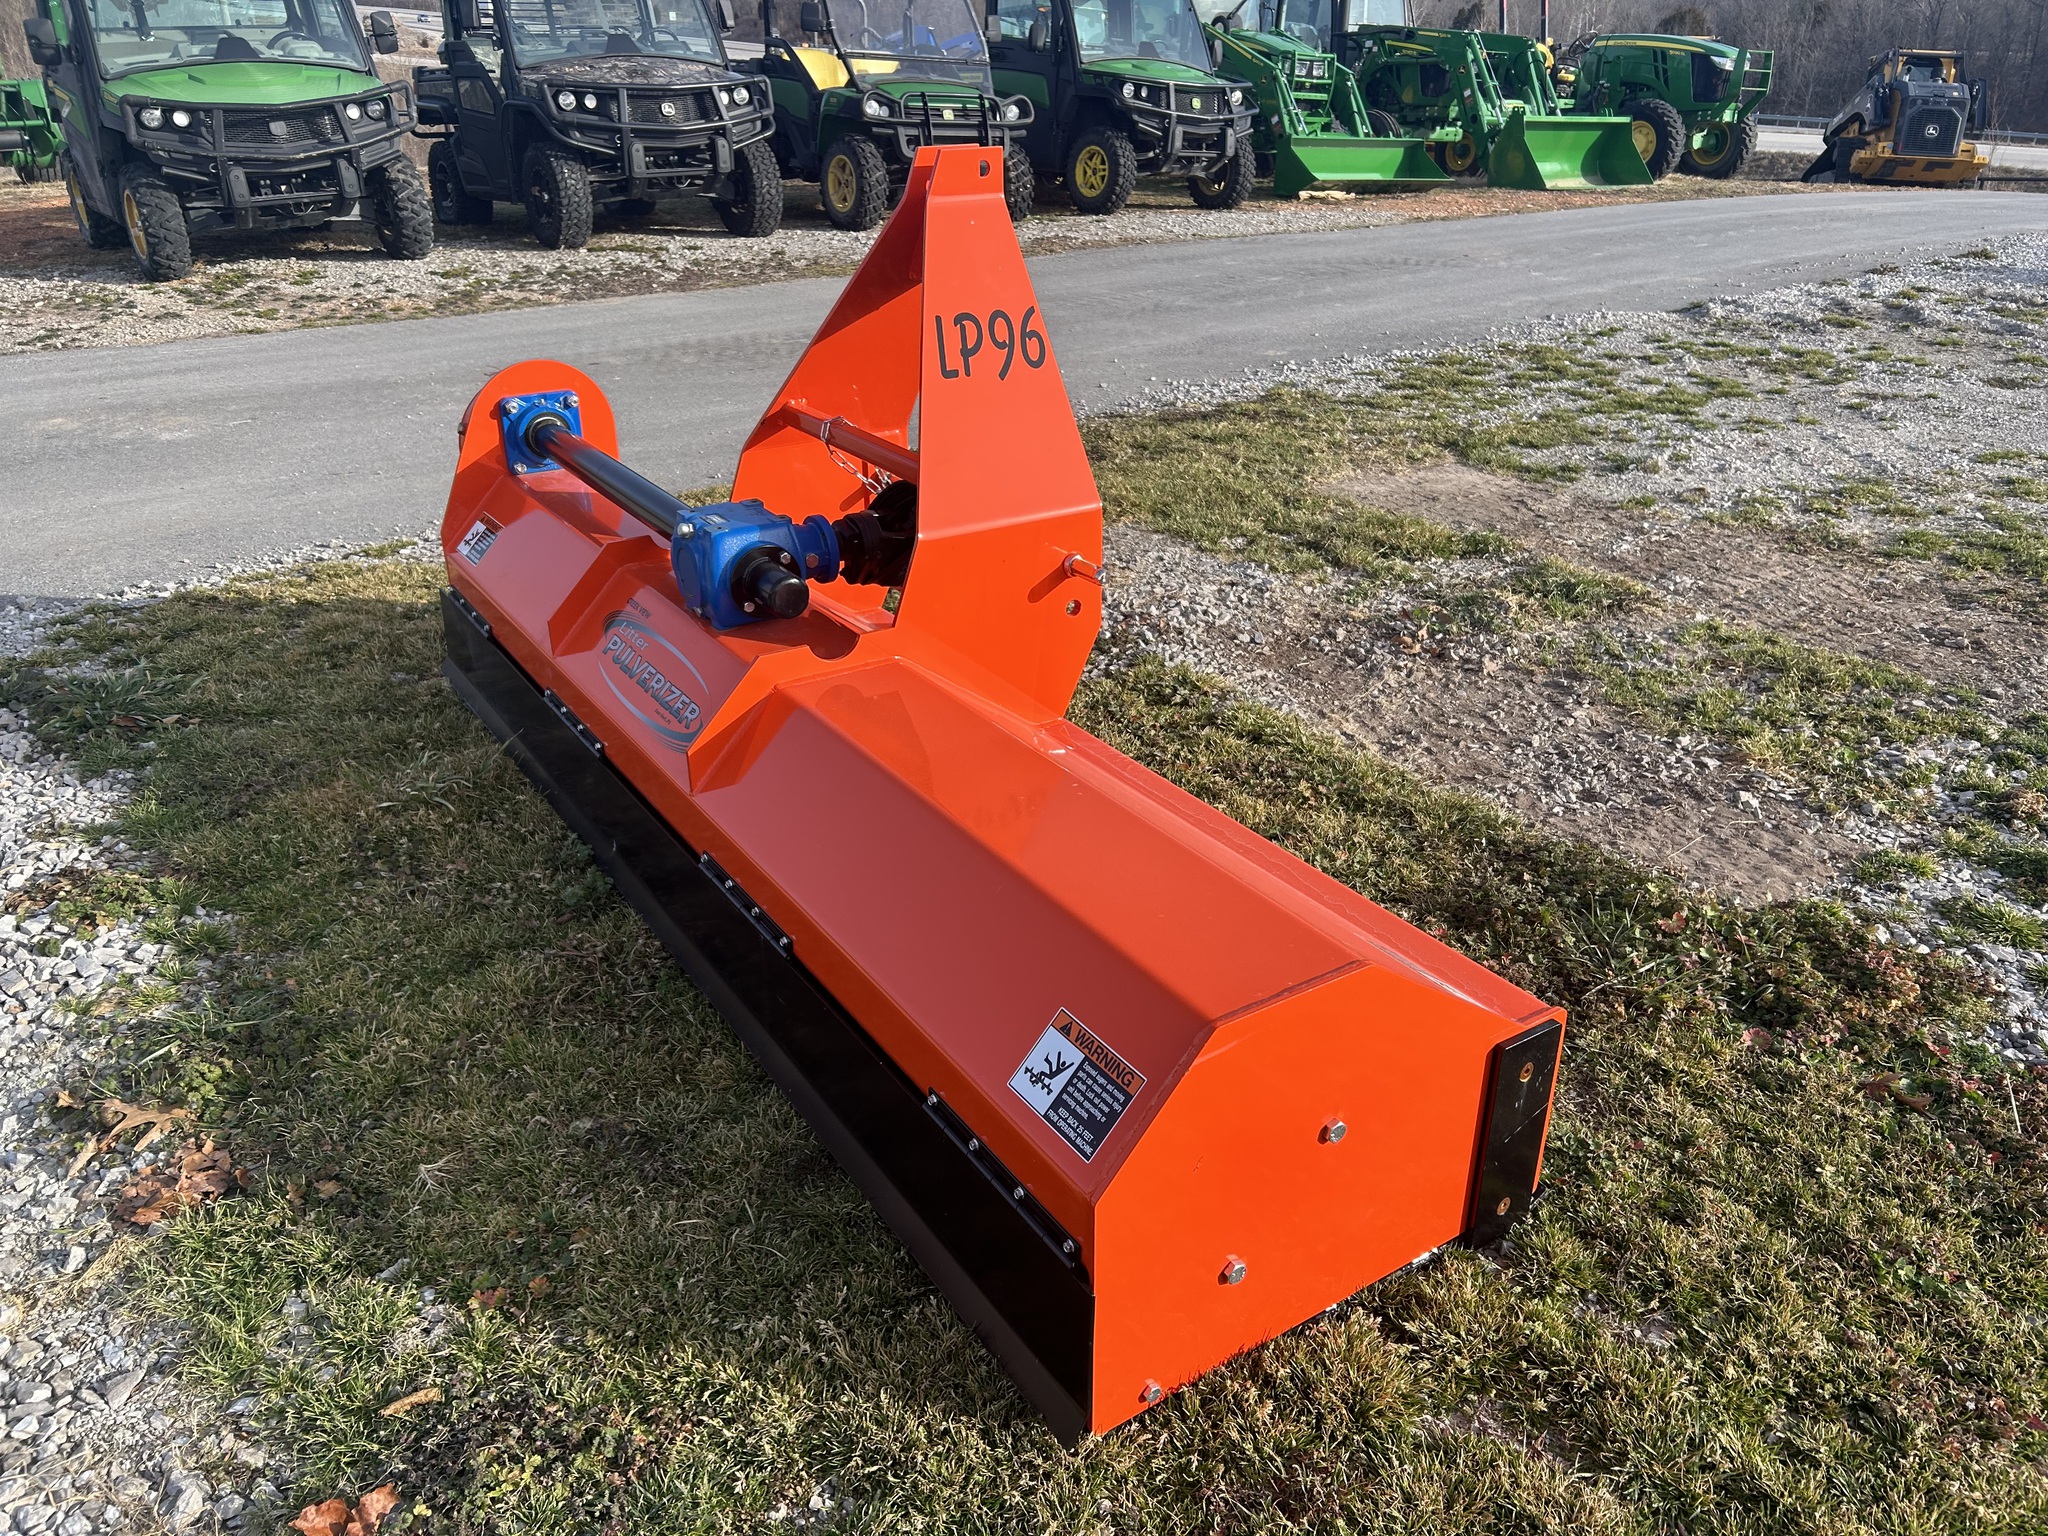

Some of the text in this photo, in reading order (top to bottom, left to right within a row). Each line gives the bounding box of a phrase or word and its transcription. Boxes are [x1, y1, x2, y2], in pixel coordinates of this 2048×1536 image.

[935, 306, 1046, 381] LP96
[618, 622, 649, 651] Litter
[602, 634, 701, 729] PULVERIZER
[1075, 1029, 1135, 1089] WARNING
[1061, 1091, 1077, 1109] servicing
[1077, 1069, 1123, 1113] parts can cause serious injury
[1083, 1061, 1098, 1077] Exposed
[1105, 1081, 1115, 1092] and
[1111, 1087, 1126, 1103] moving
[1085, 1088, 1095, 1100] Lock
[1092, 1095, 1101, 1105] out
[1098, 1100, 1110, 1114] power
[1066, 1084, 1106, 1123] unit before approaching or
[1046, 1108, 1059, 1123] FROM
[1055, 1118, 1077, 1141] OPERATING
[1057, 1106, 1093, 1143] KEEP BACK 25 FEET
